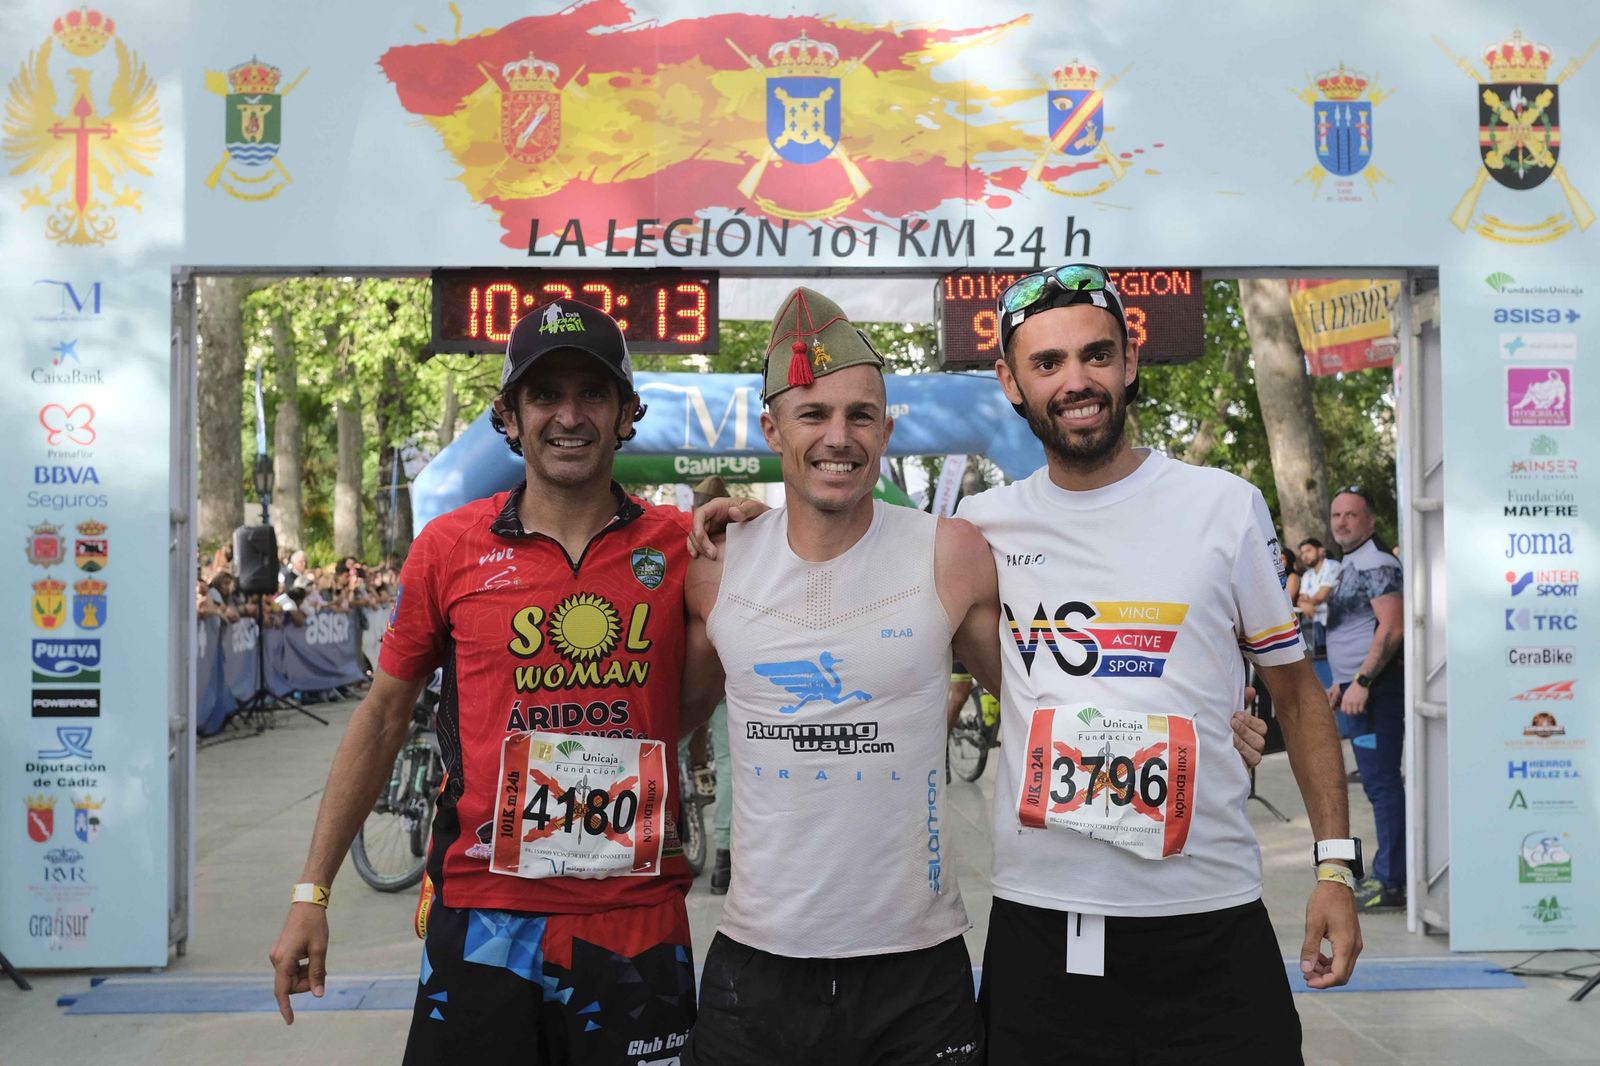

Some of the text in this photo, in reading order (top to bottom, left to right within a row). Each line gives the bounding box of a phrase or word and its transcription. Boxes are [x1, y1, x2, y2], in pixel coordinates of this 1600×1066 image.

[527, 219, 588, 257] LA
[605, 208, 788, 257] LEGIÓN
[807, 227, 878, 258] 101
[898, 218, 976, 257] KM
[994, 227, 1047, 266] 24
[1064, 217, 1092, 257] h
[31, 367, 105, 386] CaixaBank
[34, 466, 100, 485] BBVA
[27, 491, 108, 511] Seguros
[1507, 488, 1575, 502] Fundación
[1504, 505, 1578, 517] MAPFRE
[1537, 570, 1579, 584] INTER
[1537, 584, 1579, 597] SPORT
[1118, 606, 1160, 620] VINCI
[1533, 614, 1578, 630] TRC
[1111, 634, 1161, 649] ACTIVE
[34, 642, 99, 659] PULEVA
[1509, 649, 1573, 665] CeraBike
[1108, 659, 1155, 674] SPORT
[514, 660, 651, 694] WOMAN
[506, 699, 630, 733] ÁRIDOS
[746, 721, 879, 740] Running
[1102, 719, 1143, 731] Unicaja
[1078, 732, 1142, 742] Fundación
[582, 752, 619, 766] Unicaja
[1529, 760, 1573, 768] HIERROS
[25, 762, 107, 774] Diputación
[555, 764, 617, 776] Fundación
[753, 766, 902, 781] TRAIL
[33, 777, 98, 788] de Cádiz
[1049, 755, 1168, 808] 3796
[1175, 774, 1187, 818] EDICIÓN
[522, 783, 638, 836] 4180
[627, 1036, 663, 1056] Club
